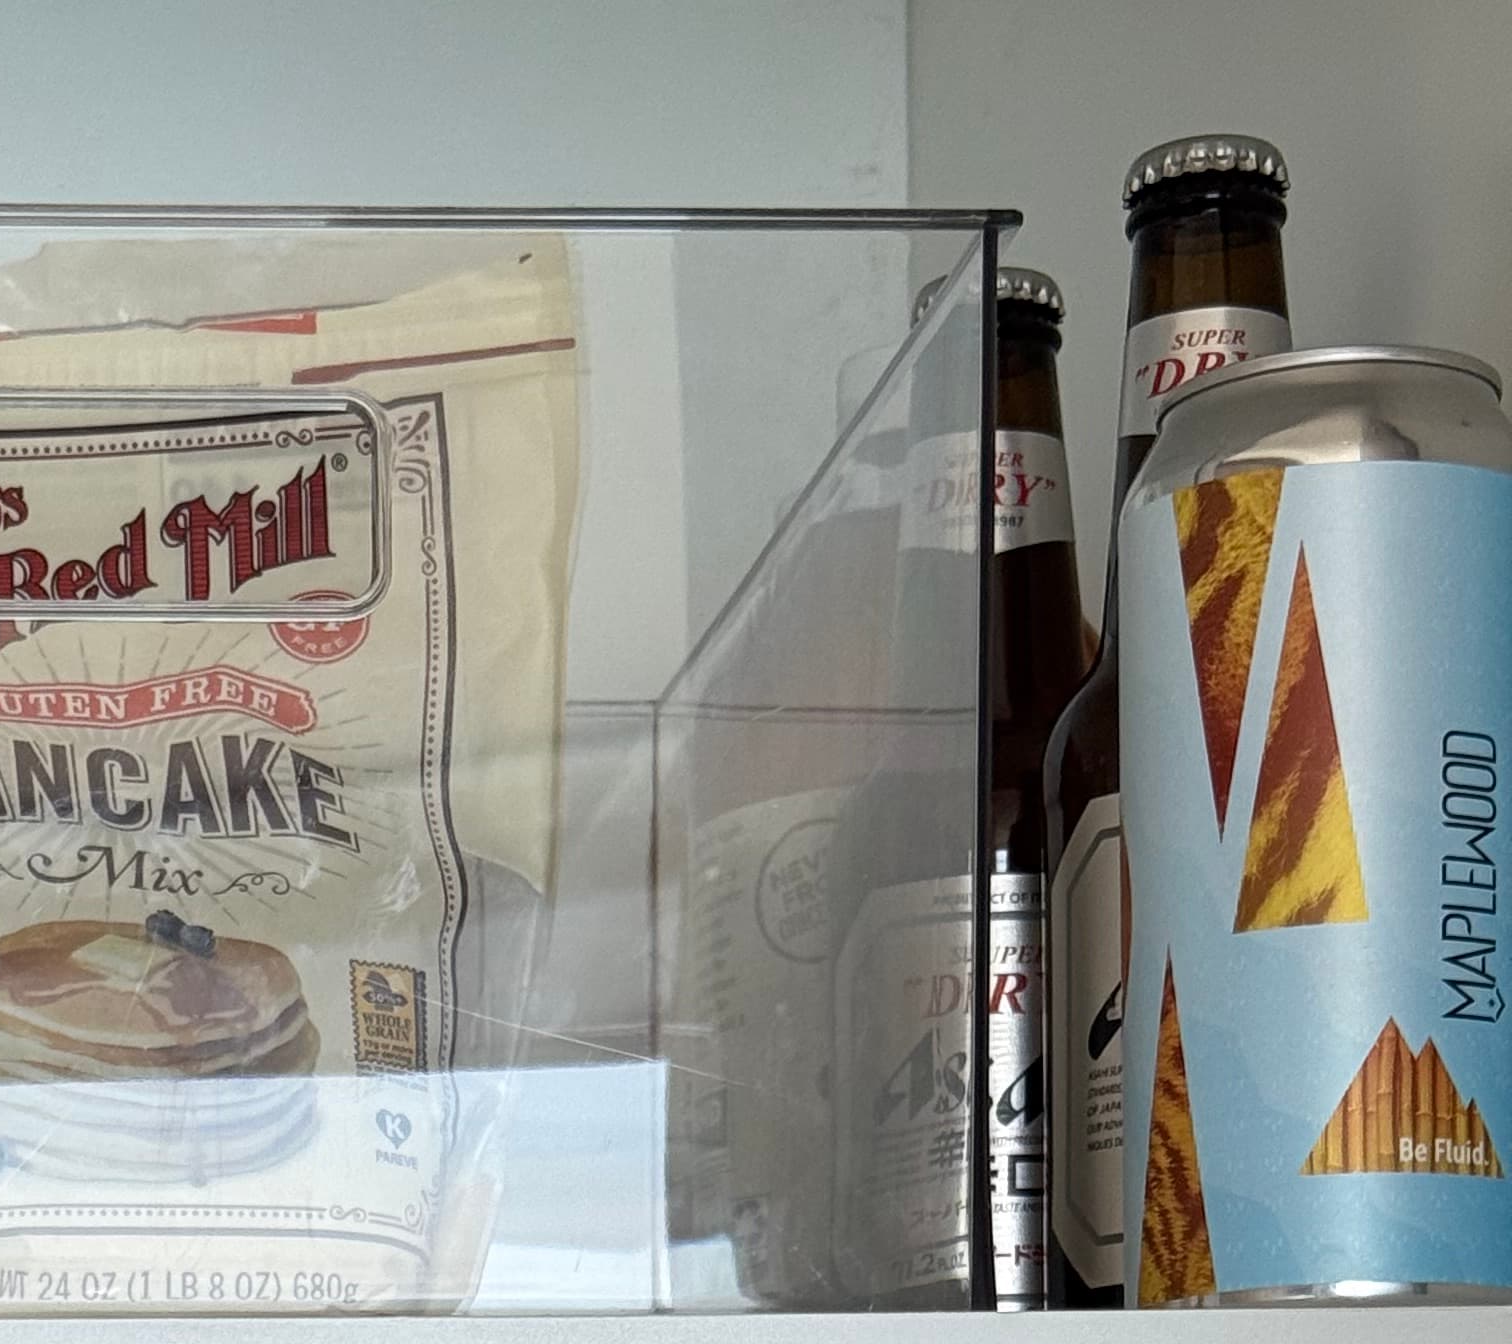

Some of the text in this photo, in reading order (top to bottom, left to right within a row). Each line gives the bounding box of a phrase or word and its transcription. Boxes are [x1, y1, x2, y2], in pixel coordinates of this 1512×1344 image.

[1171, 328, 1246, 351] SUPER
[149, 674, 278, 717] FREE
[26, 844, 205, 897] Mix
[1441, 729, 1506, 1024] MAPLEWOOD
[362, 1011, 412, 1031] WHOLE
[365, 1024, 411, 1043] GRAIN
[375, 1149, 419, 1171] PAREVE
[1399, 1137, 1489, 1166] Be Fluid.
[38, 1271, 70, 1301] 24
[81, 1271, 116, 1301] OZ
[128, 1270, 150, 1303] (1
[166, 1271, 198, 1300] LB
[209, 1271, 225, 1300] 8
[235, 1271, 282, 1301] OZ)
[293, 1271, 359, 1304] 680g
